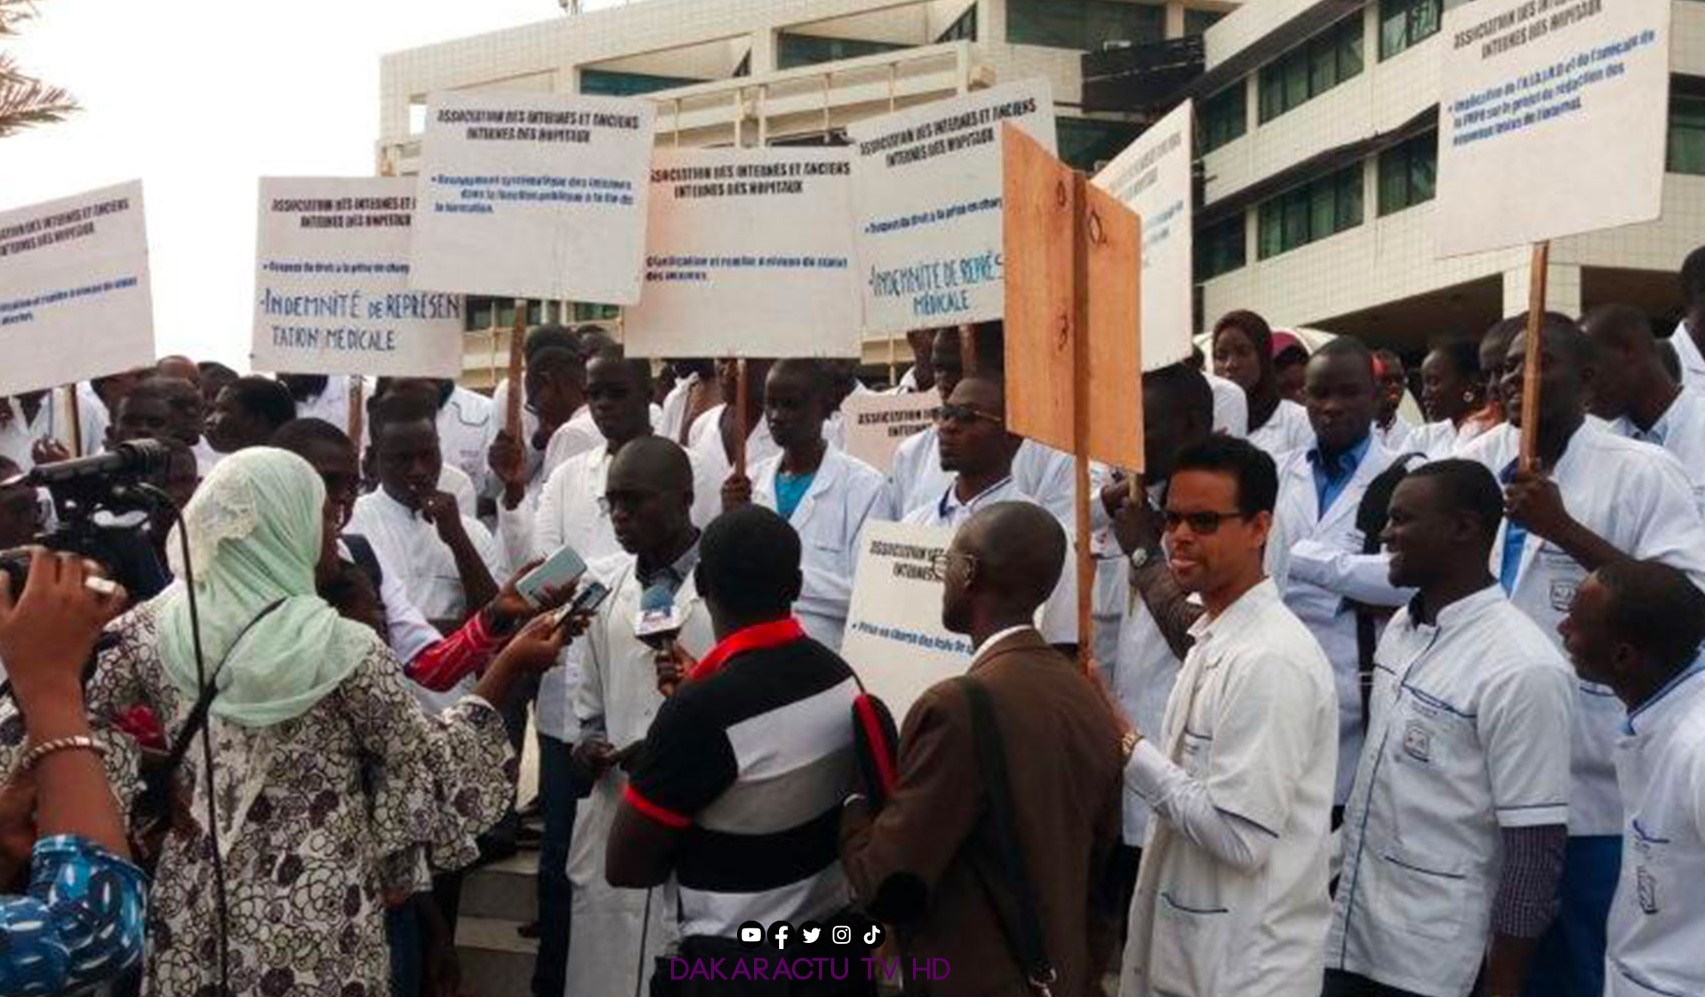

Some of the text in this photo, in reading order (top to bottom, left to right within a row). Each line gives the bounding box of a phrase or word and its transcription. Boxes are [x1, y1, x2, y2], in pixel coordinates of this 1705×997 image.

[437, 108, 639, 130] ASSOCIATION DES INTERNES ET ANCIENS
[466, 126, 515, 140] INTERNES
[516, 126, 536, 140] DES
[860, 127, 916, 156] ASSOCIATION
[934, 110, 979, 135] INTERNES
[979, 104, 991, 124] ET
[885, 148, 928, 168] INTERNES
[713, 164, 734, 180] DES
[736, 162, 788, 178] INTERNES
[789, 162, 802, 177] ET
[803, 161, 851, 176] ANCIENS
[673, 182, 725, 199] INTERNES
[727, 181, 748, 196] DES
[271, 198, 333, 212] ASSOCIATION
[354, 197, 399, 211] INTERNES
[400, 196, 411, 210] ET
[367, 300, 384, 319] DE
[272, 326, 319, 348] TATION
[858, 409, 922, 425] ASSOCIATION
